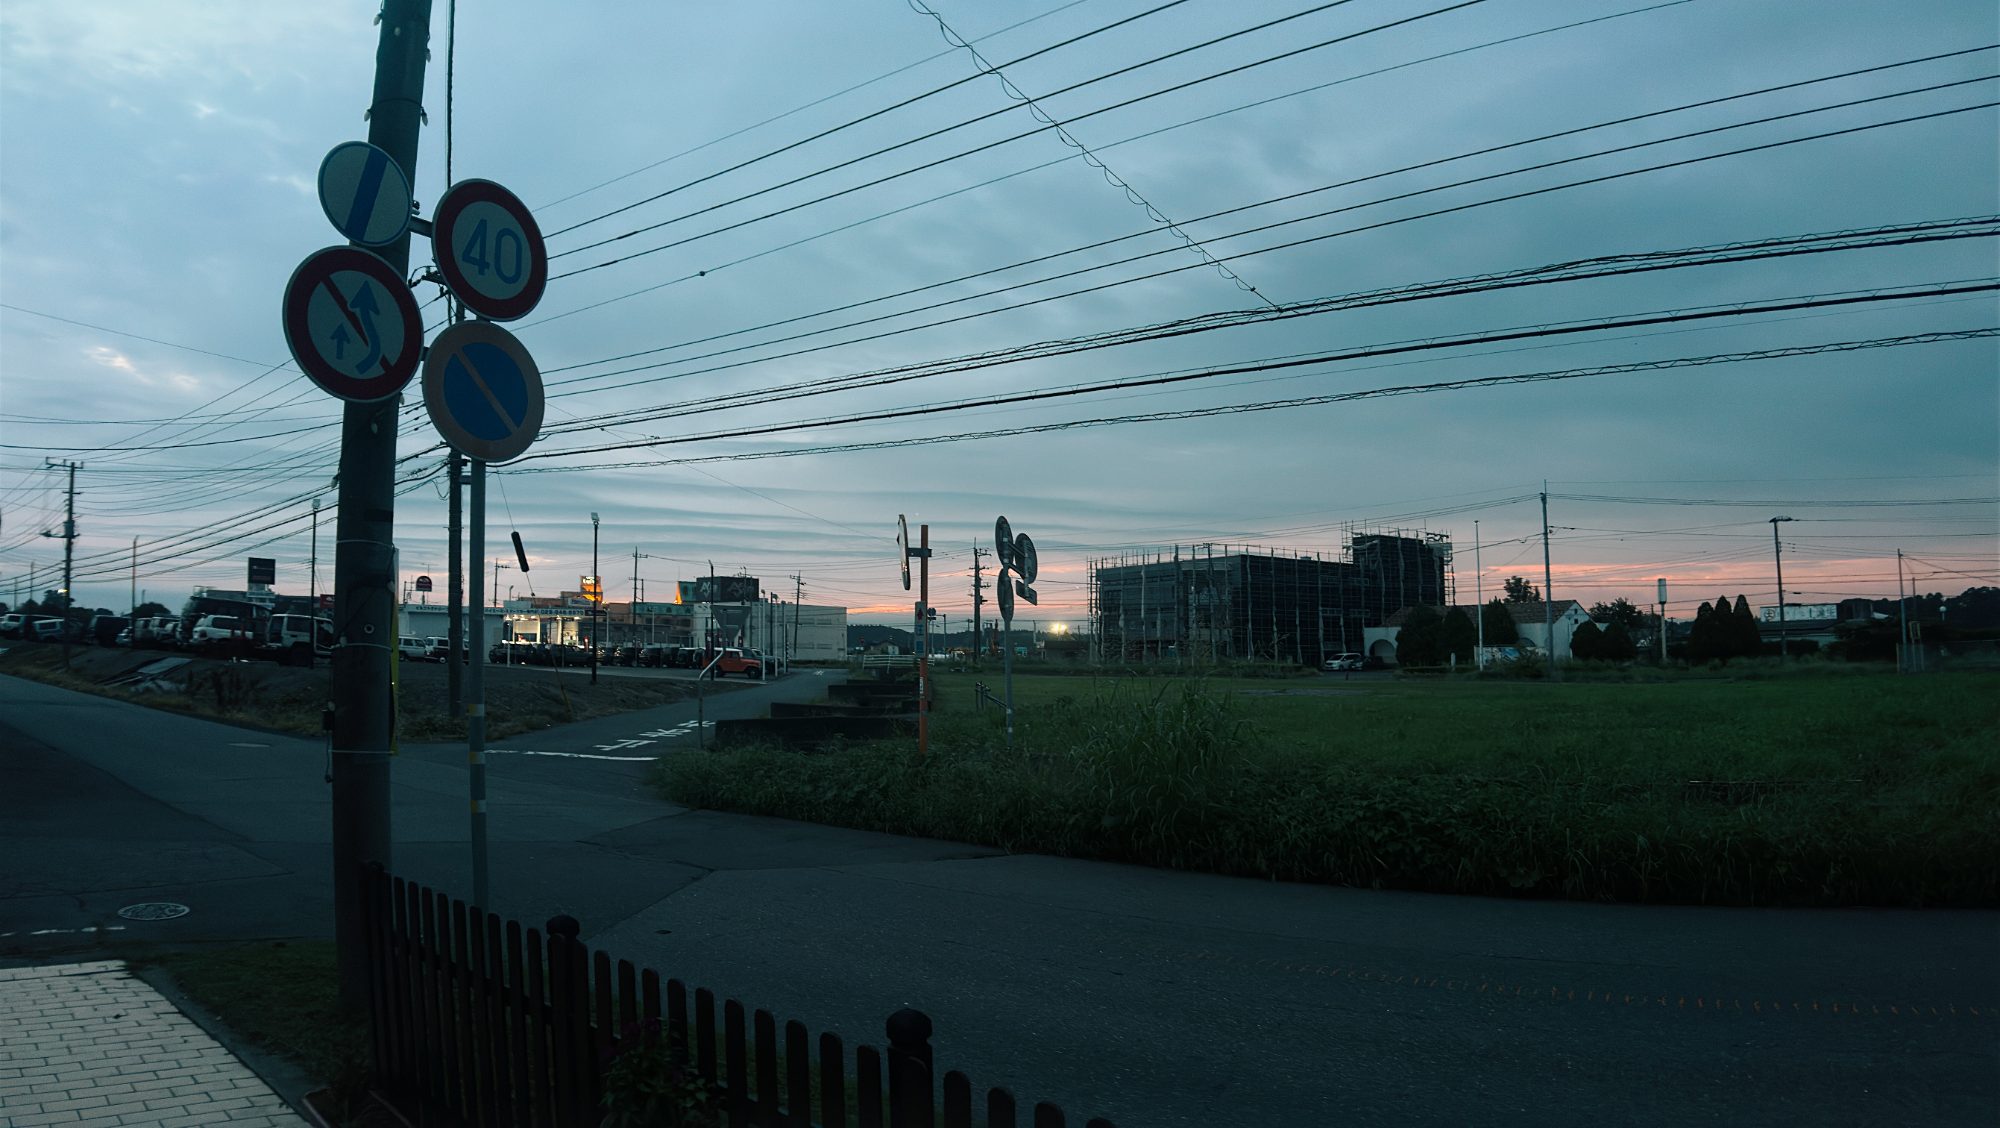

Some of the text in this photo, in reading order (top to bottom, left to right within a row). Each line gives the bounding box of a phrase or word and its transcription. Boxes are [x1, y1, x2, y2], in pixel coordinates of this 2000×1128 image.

[462, 219, 522, 284] 40
[592, 719, 717, 751] 止まれ
